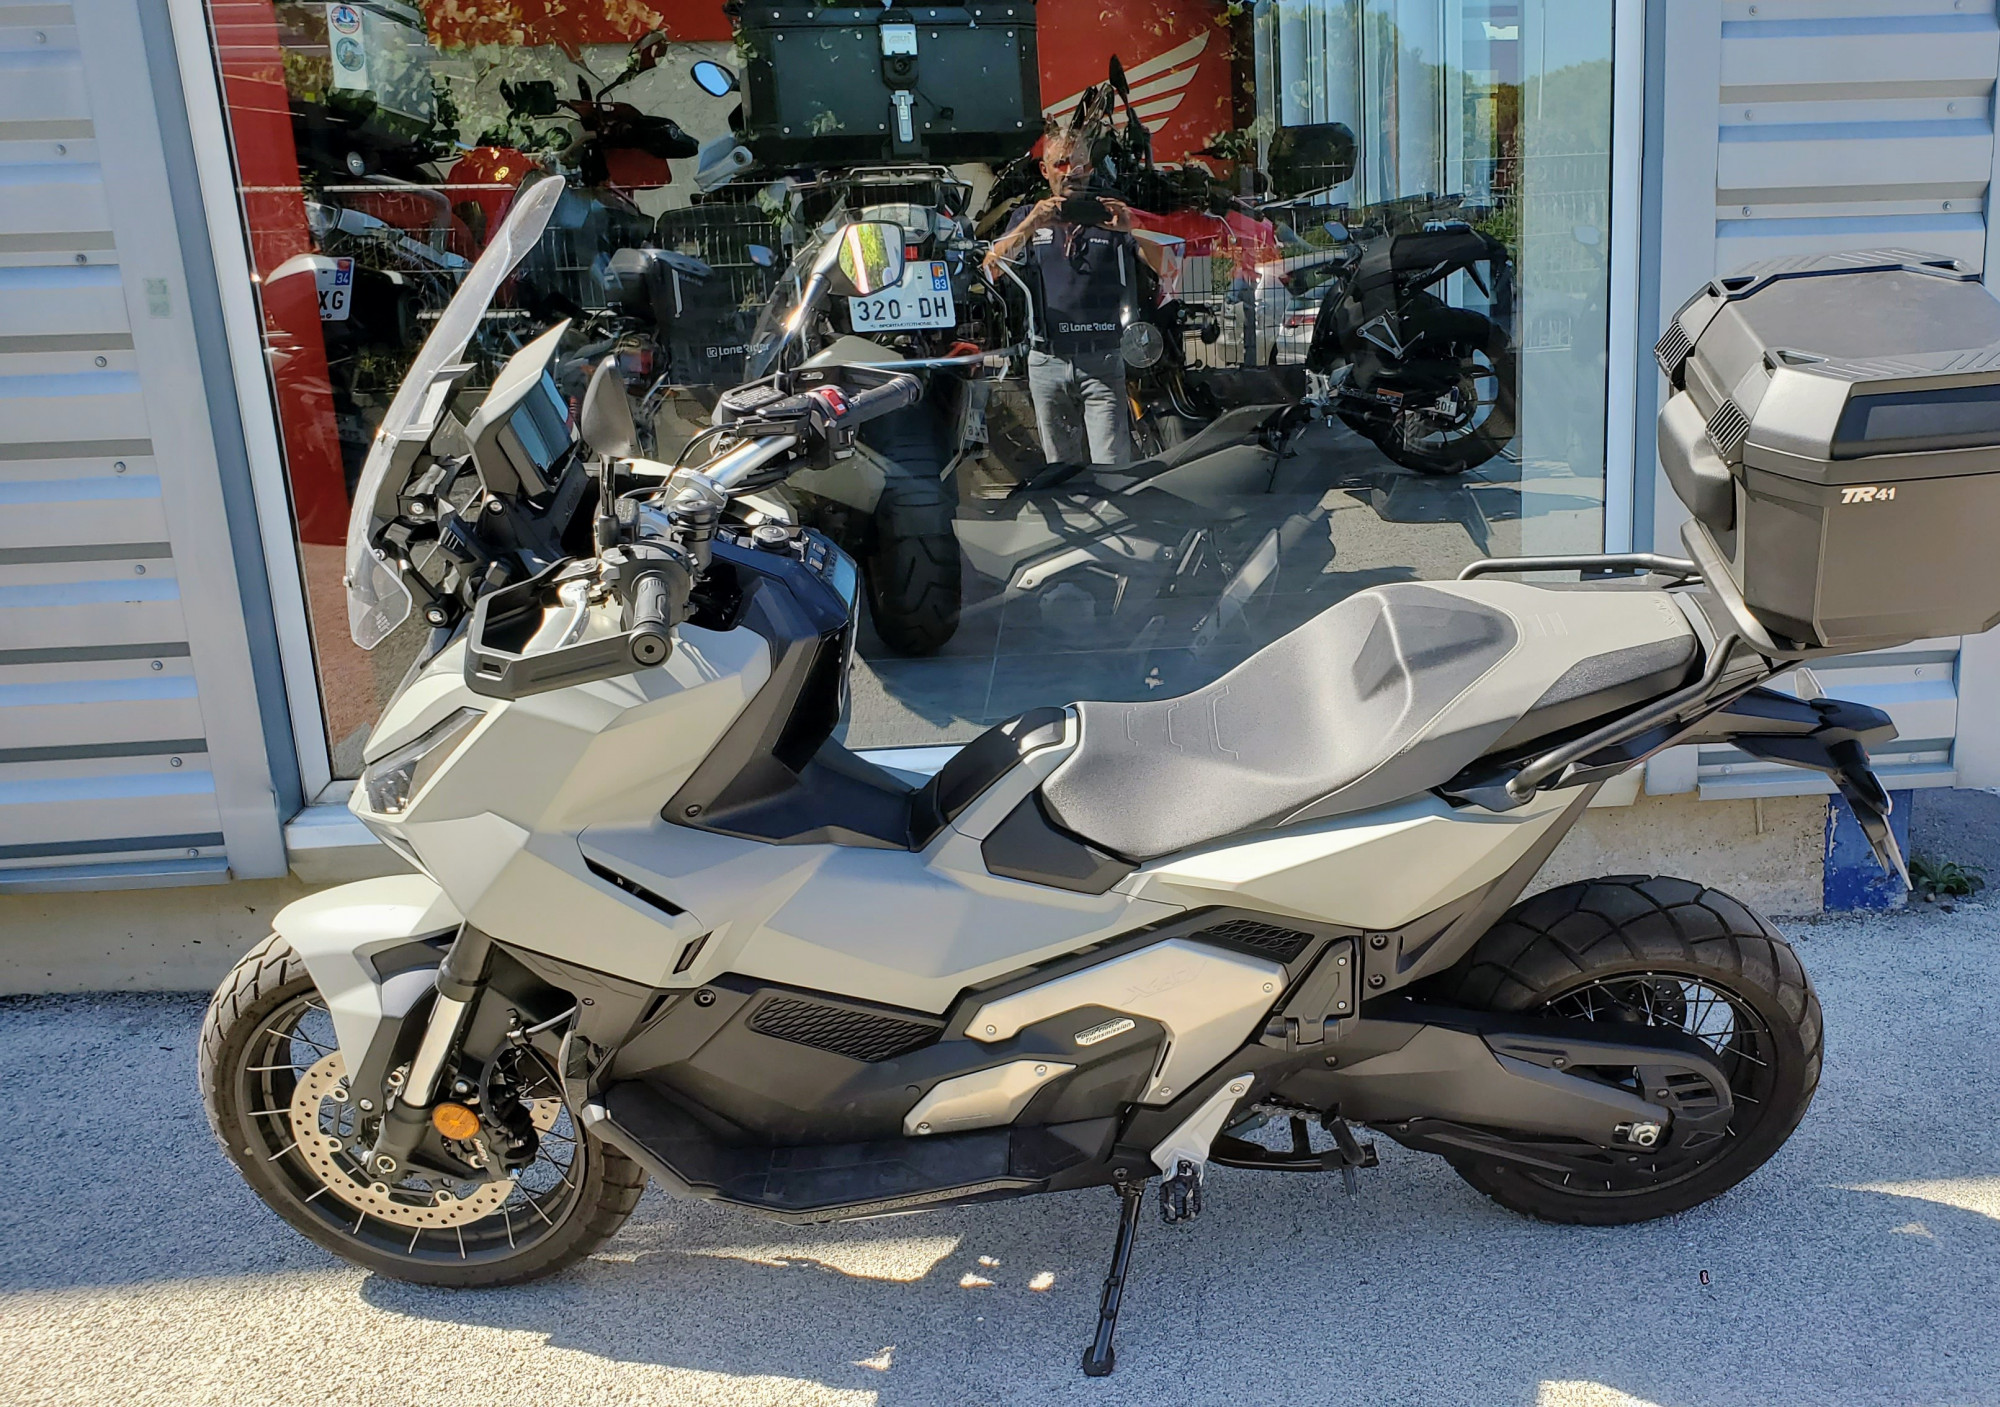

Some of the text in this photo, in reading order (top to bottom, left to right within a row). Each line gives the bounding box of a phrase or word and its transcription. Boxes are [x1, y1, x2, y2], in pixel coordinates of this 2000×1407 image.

[336, 272, 349, 284] 34
[934, 279, 947, 290] 83
[1085, 1021, 1132, 1044] Transmission
